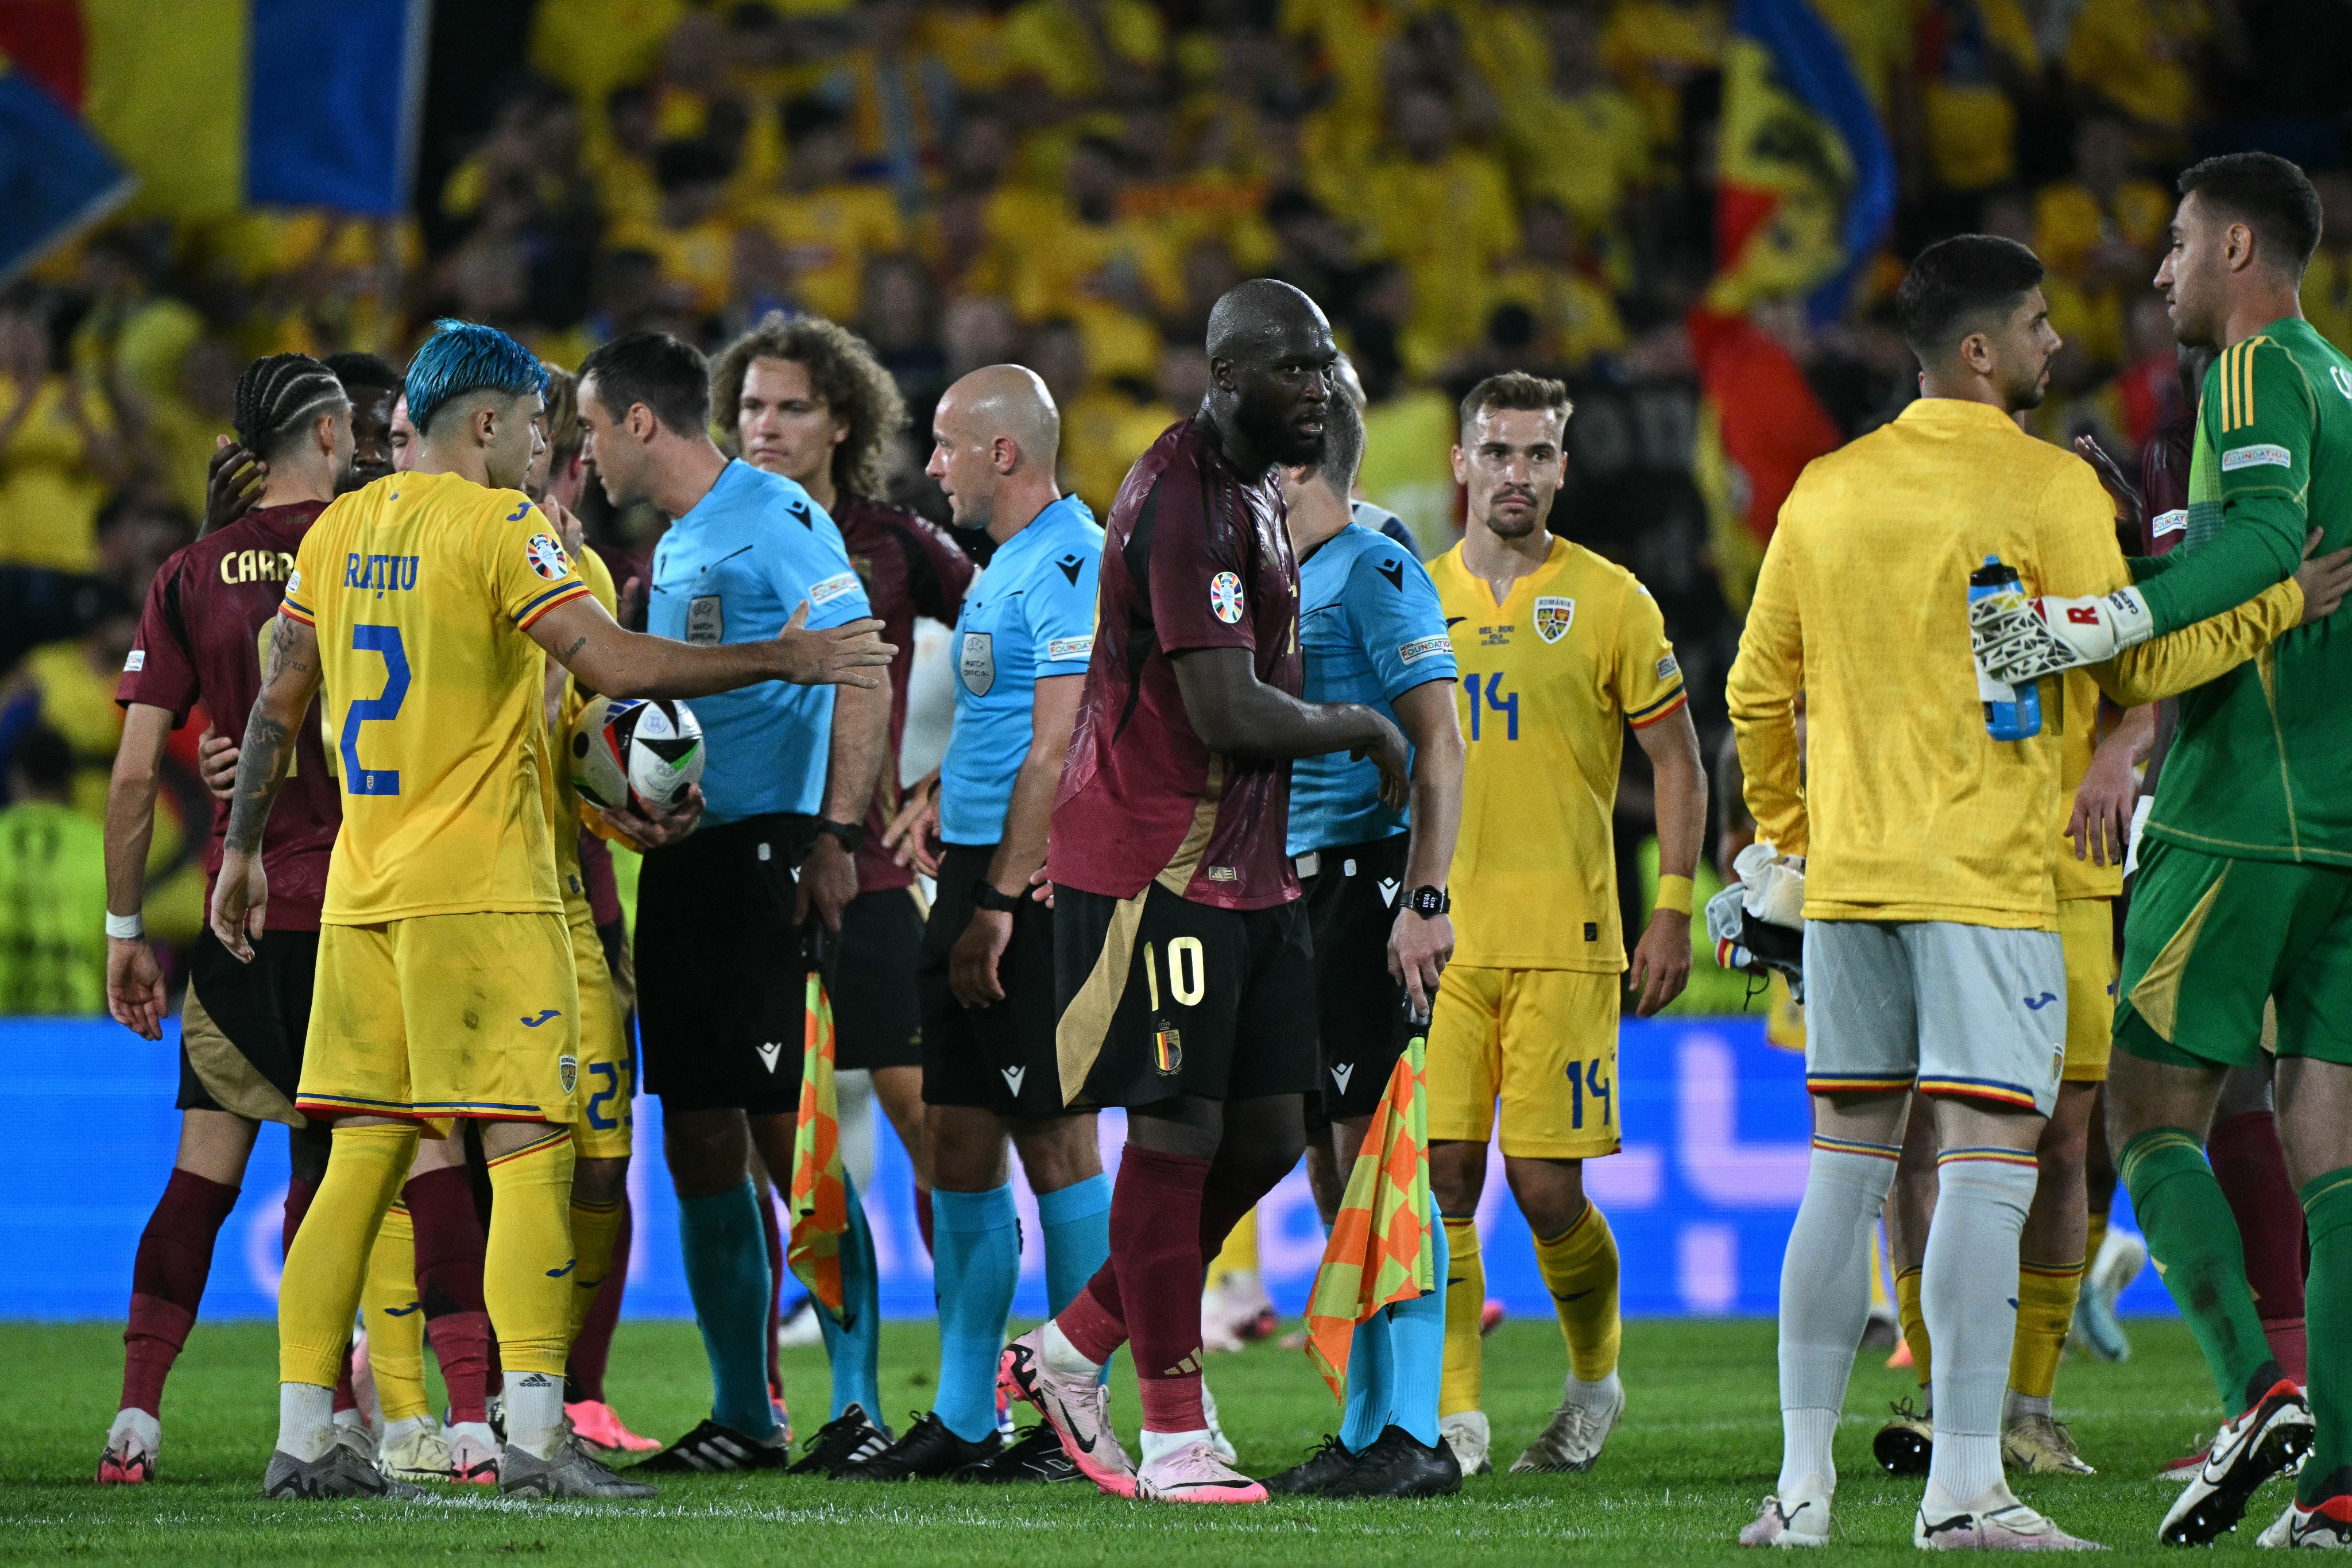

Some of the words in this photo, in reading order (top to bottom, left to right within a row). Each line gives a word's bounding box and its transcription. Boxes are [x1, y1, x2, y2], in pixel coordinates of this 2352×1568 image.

[343, 552, 420, 599] RAȚIU
[1401, 640, 1450, 659] FOUNDATIO
[340, 624, 412, 796] 2
[1463, 671, 1519, 741] 14
[1143, 936, 1205, 1012] 10
[1565, 1057, 1610, 1129] 14
